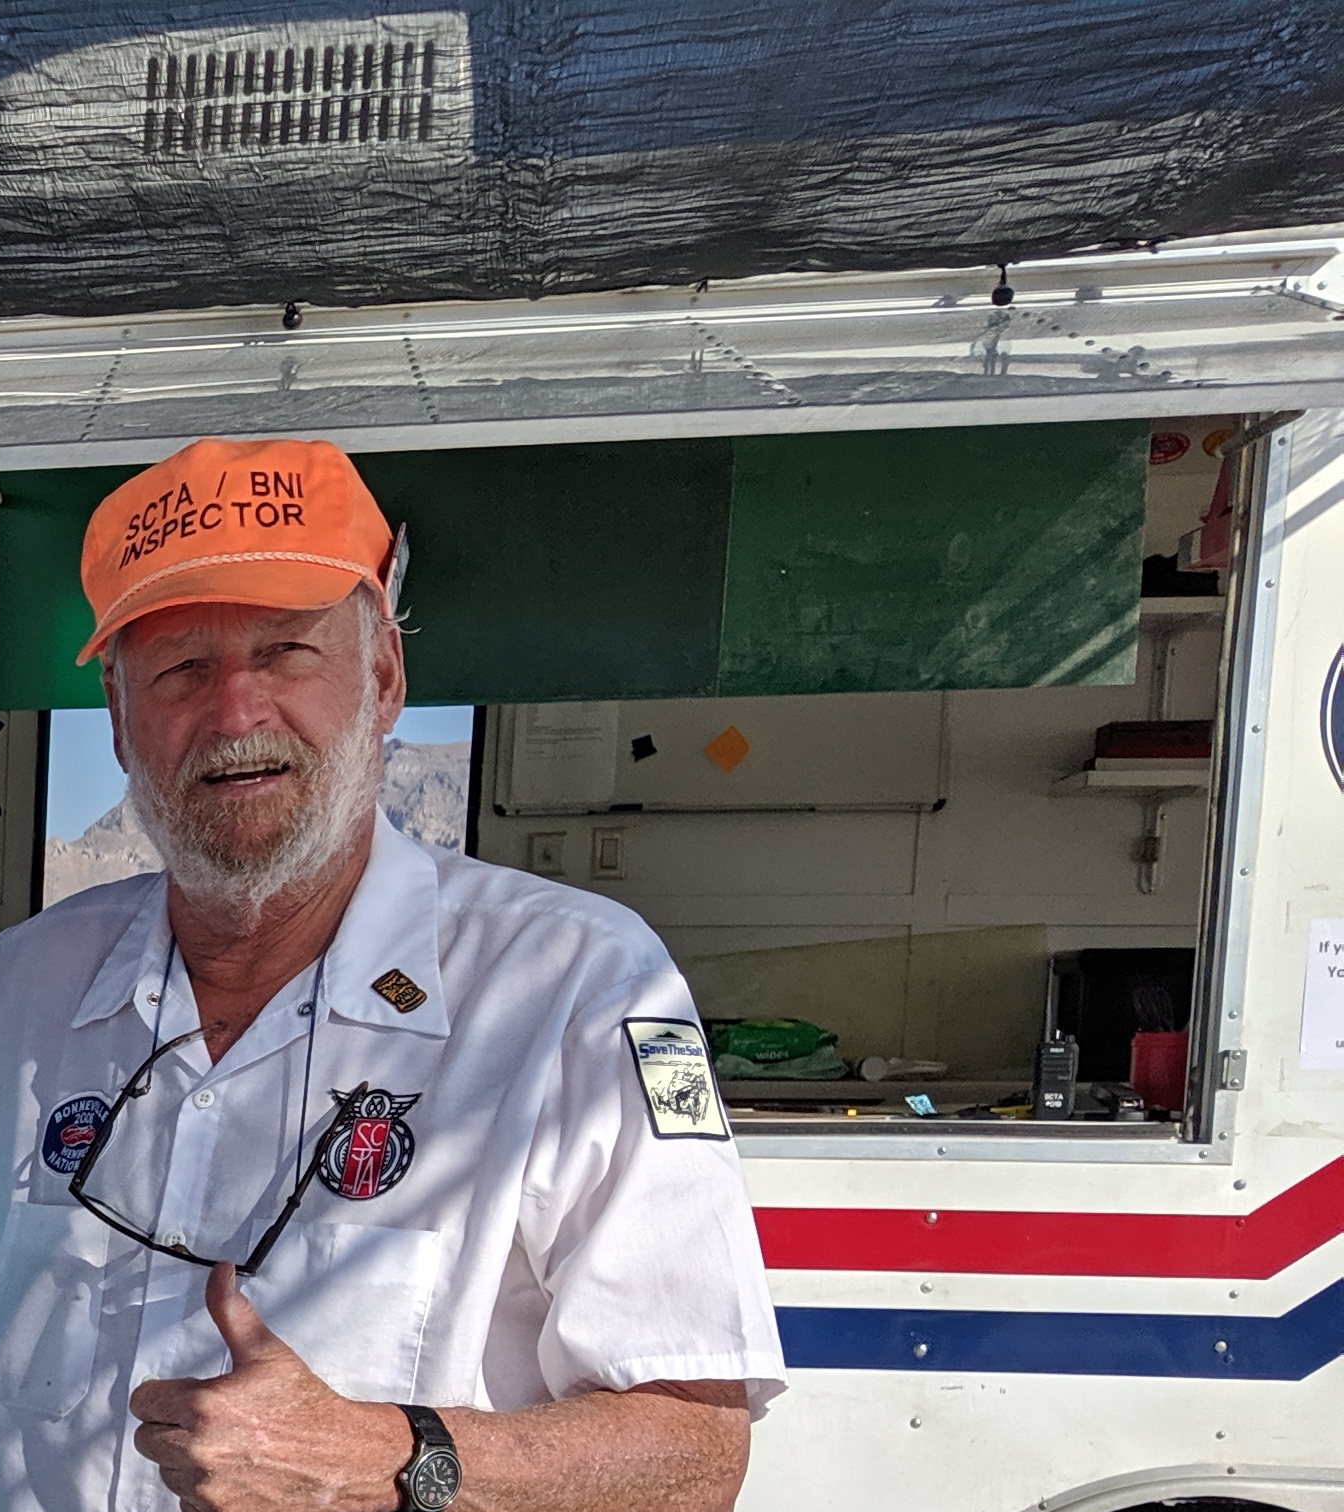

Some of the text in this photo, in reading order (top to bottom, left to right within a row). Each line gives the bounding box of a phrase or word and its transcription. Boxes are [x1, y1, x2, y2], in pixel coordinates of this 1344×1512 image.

[118, 501, 305, 570] INSPECTOR
[124, 482, 194, 541] SCTA
[250, 471, 305, 499] BNI
[1319, 941, 1330, 954] If
